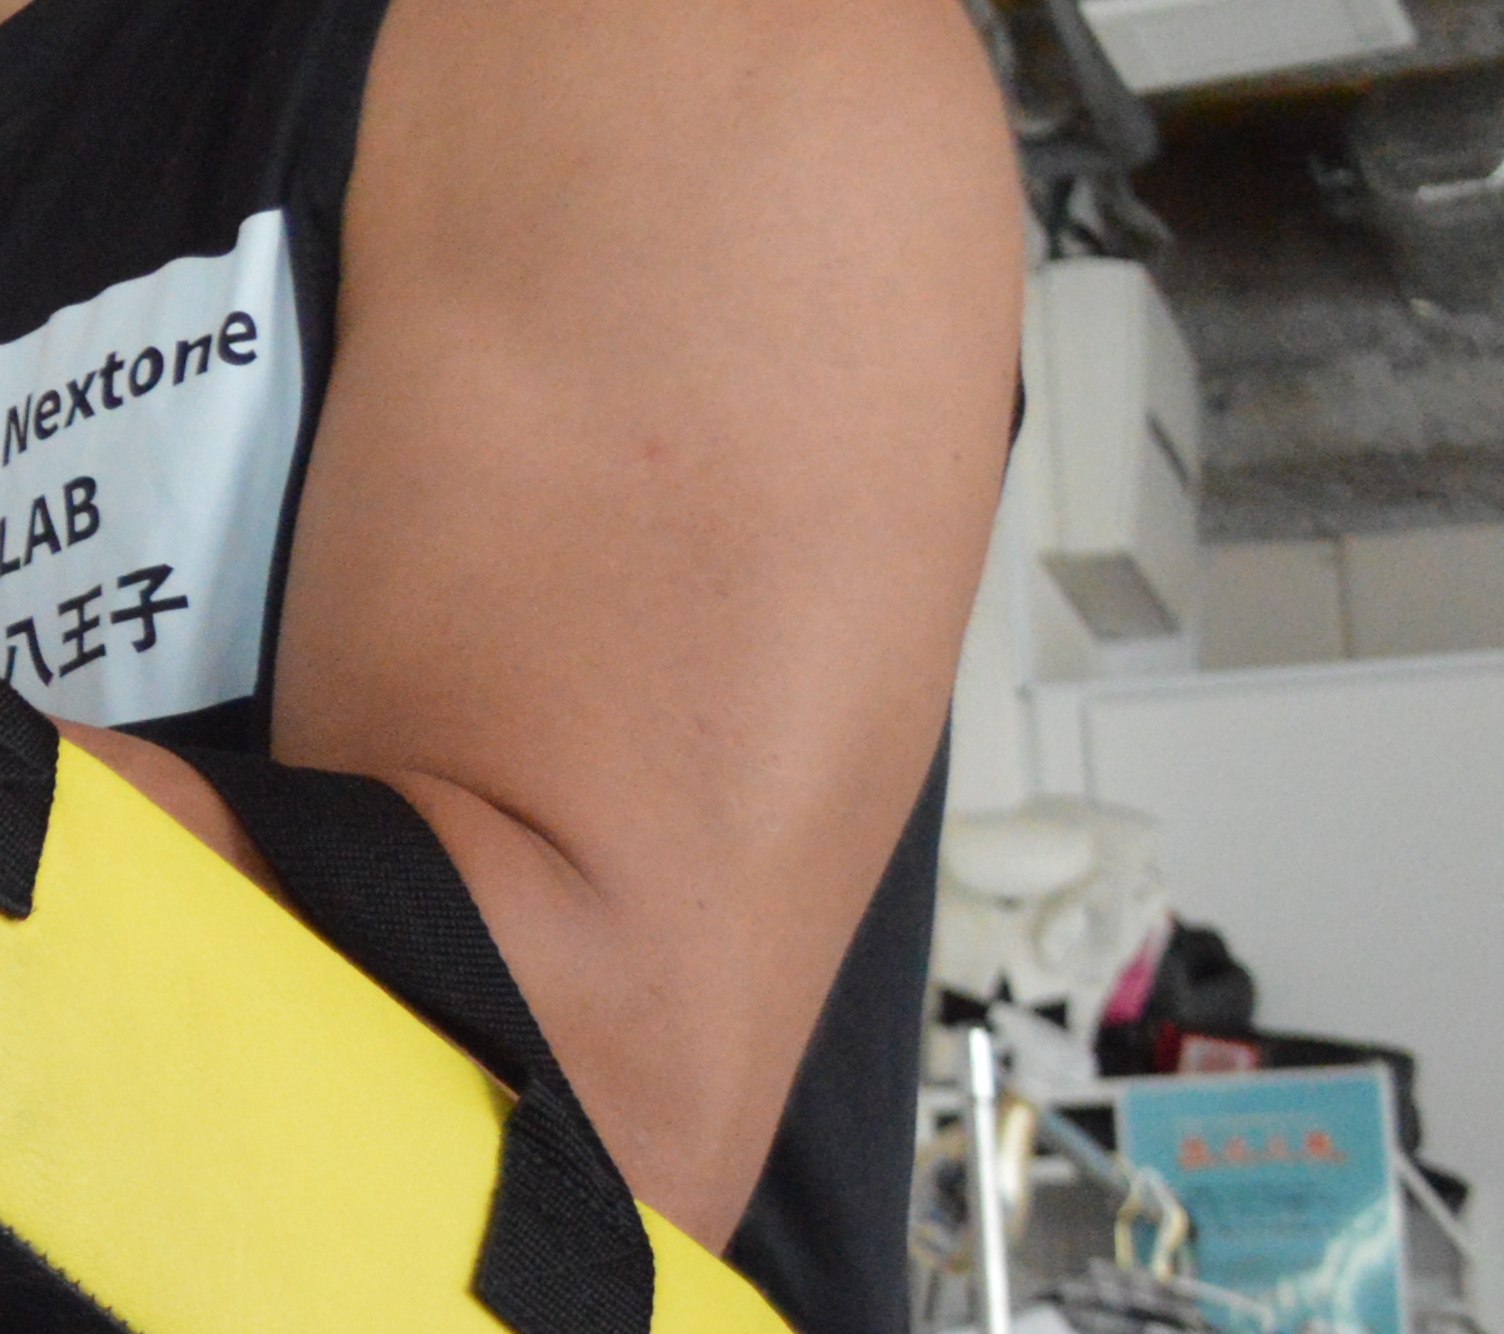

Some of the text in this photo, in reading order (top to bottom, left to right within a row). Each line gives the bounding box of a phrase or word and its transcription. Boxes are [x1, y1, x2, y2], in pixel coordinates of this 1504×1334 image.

[1, 310, 259, 467] Nextone
[2, 563, 189, 688] 八王子
